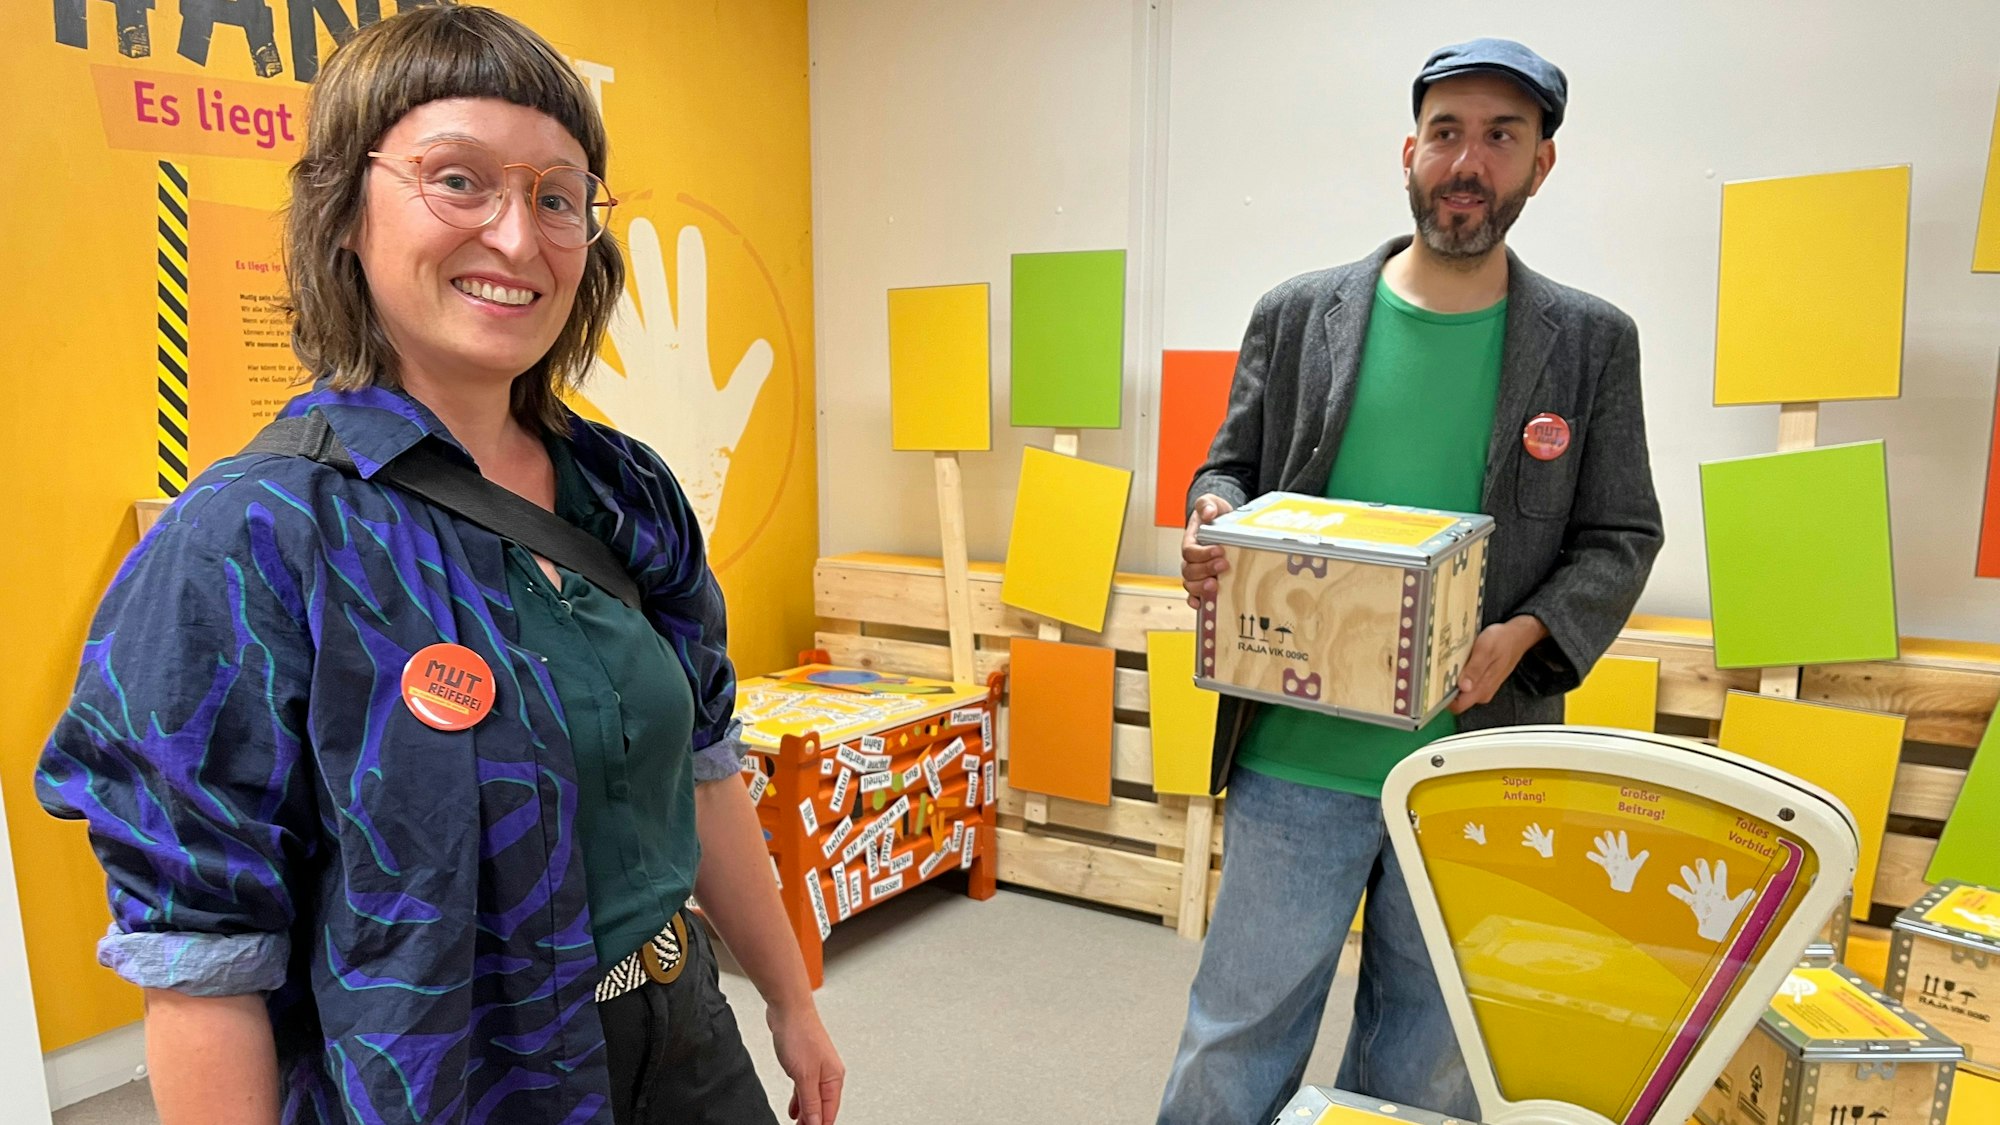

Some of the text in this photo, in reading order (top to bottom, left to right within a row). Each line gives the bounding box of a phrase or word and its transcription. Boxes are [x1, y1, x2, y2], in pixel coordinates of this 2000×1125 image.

[134, 80, 294, 149] Es liegt
[235, 260, 245, 270] Es
[248, 261, 269, 273] liegt
[1534, 425, 1562, 443] MUT
[1238, 642, 1309, 661] RAJA VIK 009C
[424, 659, 482, 694] MUT
[863, 738, 883, 751] Bahn
[936, 742, 963, 769] zuhören
[841, 747, 866, 766] warten
[749, 777, 767, 801] Erde
[833, 771, 849, 807] Natur
[863, 773, 890, 789] schnell
[968, 775, 977, 804] mehr
[1502, 775, 1533, 787] Super
[1503, 790, 1546, 803] Anfang!
[1621, 786, 1660, 802] Großer
[1618, 801, 1665, 821] Beitrag!
[825, 821, 851, 854] helfen
[846, 801, 906, 856] ist wichtiger als
[1736, 816, 1769, 839] Tolles
[882, 833, 893, 862] Wald
[965, 832, 973, 863] essen
[1729, 830, 1776, 859] Vorbild!
[892, 854, 911, 870] nicht
[834, 867, 848, 917] Zukunft
[852, 876, 860, 903] Luft
[873, 879, 900, 896] Wasser
[1919, 996, 1949, 1010] RAJA
